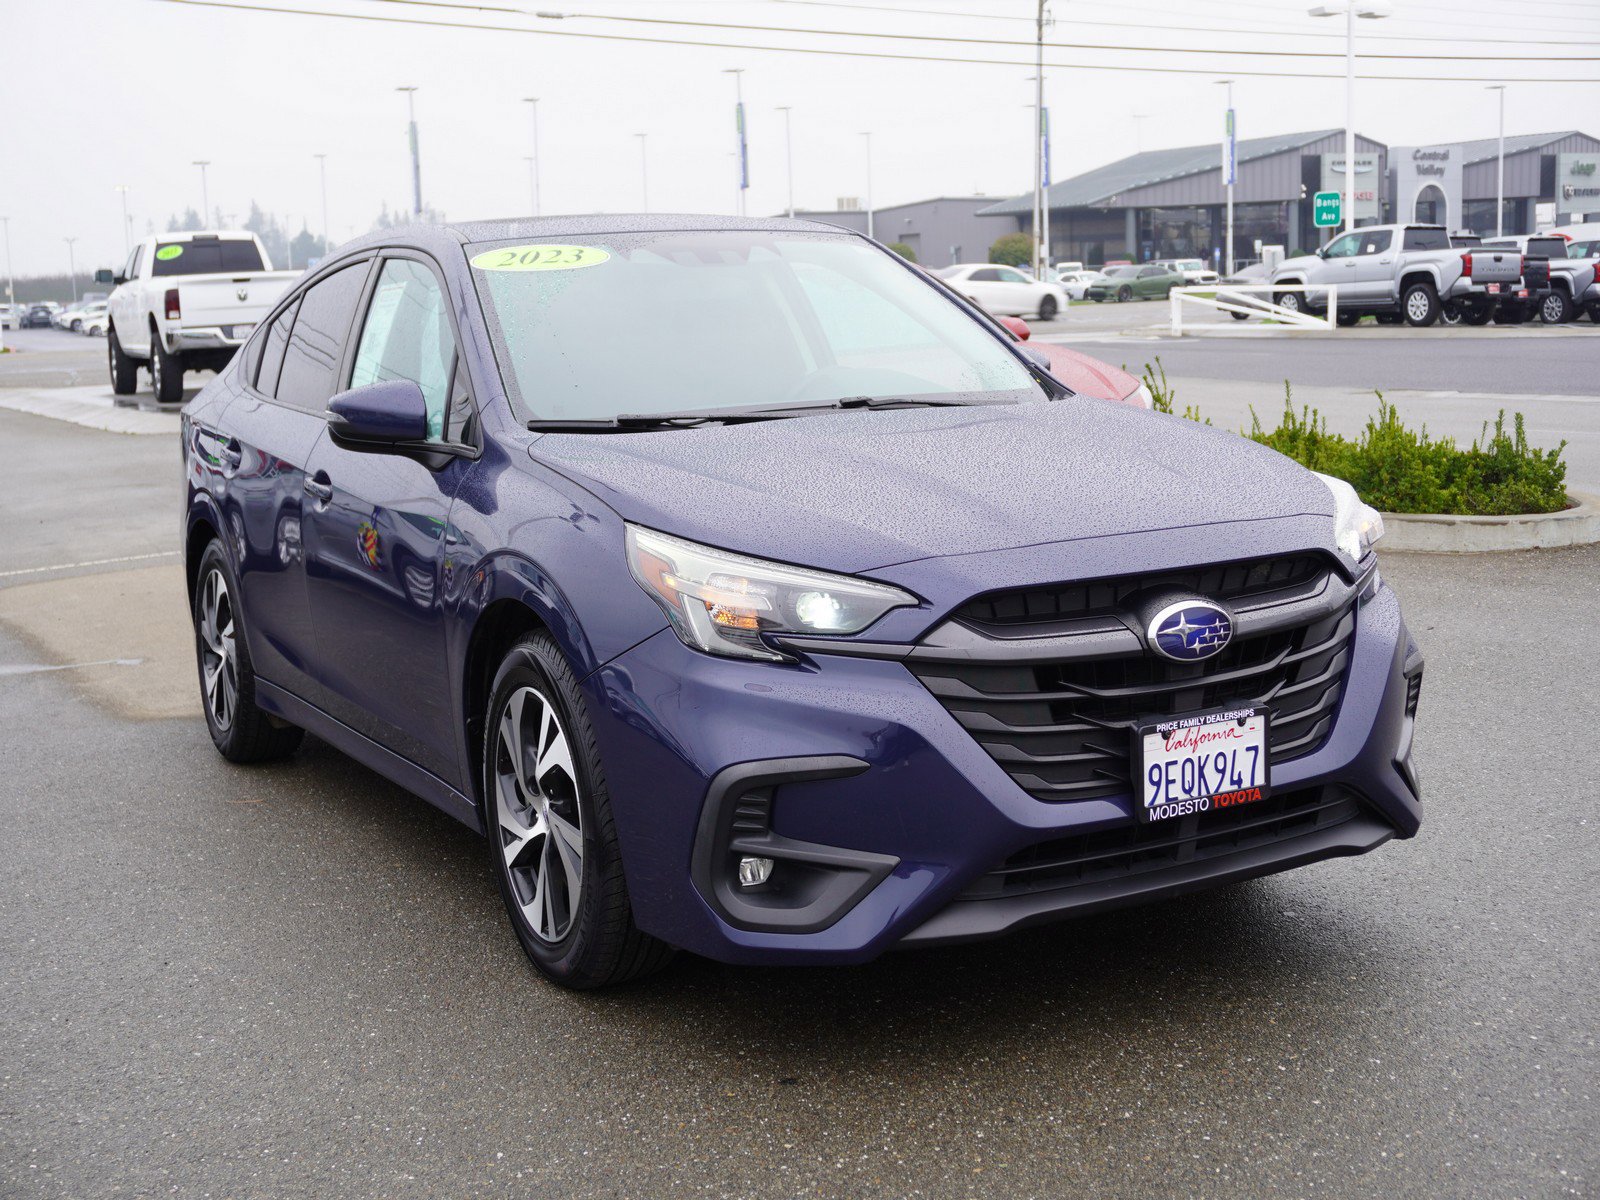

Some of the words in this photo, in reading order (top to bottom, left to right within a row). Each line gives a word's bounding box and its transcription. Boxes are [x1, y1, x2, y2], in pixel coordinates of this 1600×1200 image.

[1316, 198, 1340, 208] Bangs
[1321, 212, 1336, 221] Ave
[497, 249, 585, 267] 2023
[1156, 722, 1178, 732] PRICE
[1179, 716, 1205, 728] FAMILY
[1206, 708, 1255, 724] DEALERSHIPS
[1165, 723, 1244, 753] California
[1148, 745, 1259, 806] 9EQK947
[1149, 797, 1210, 821] MODESTO
[1212, 788, 1262, 808] TOYOTA
